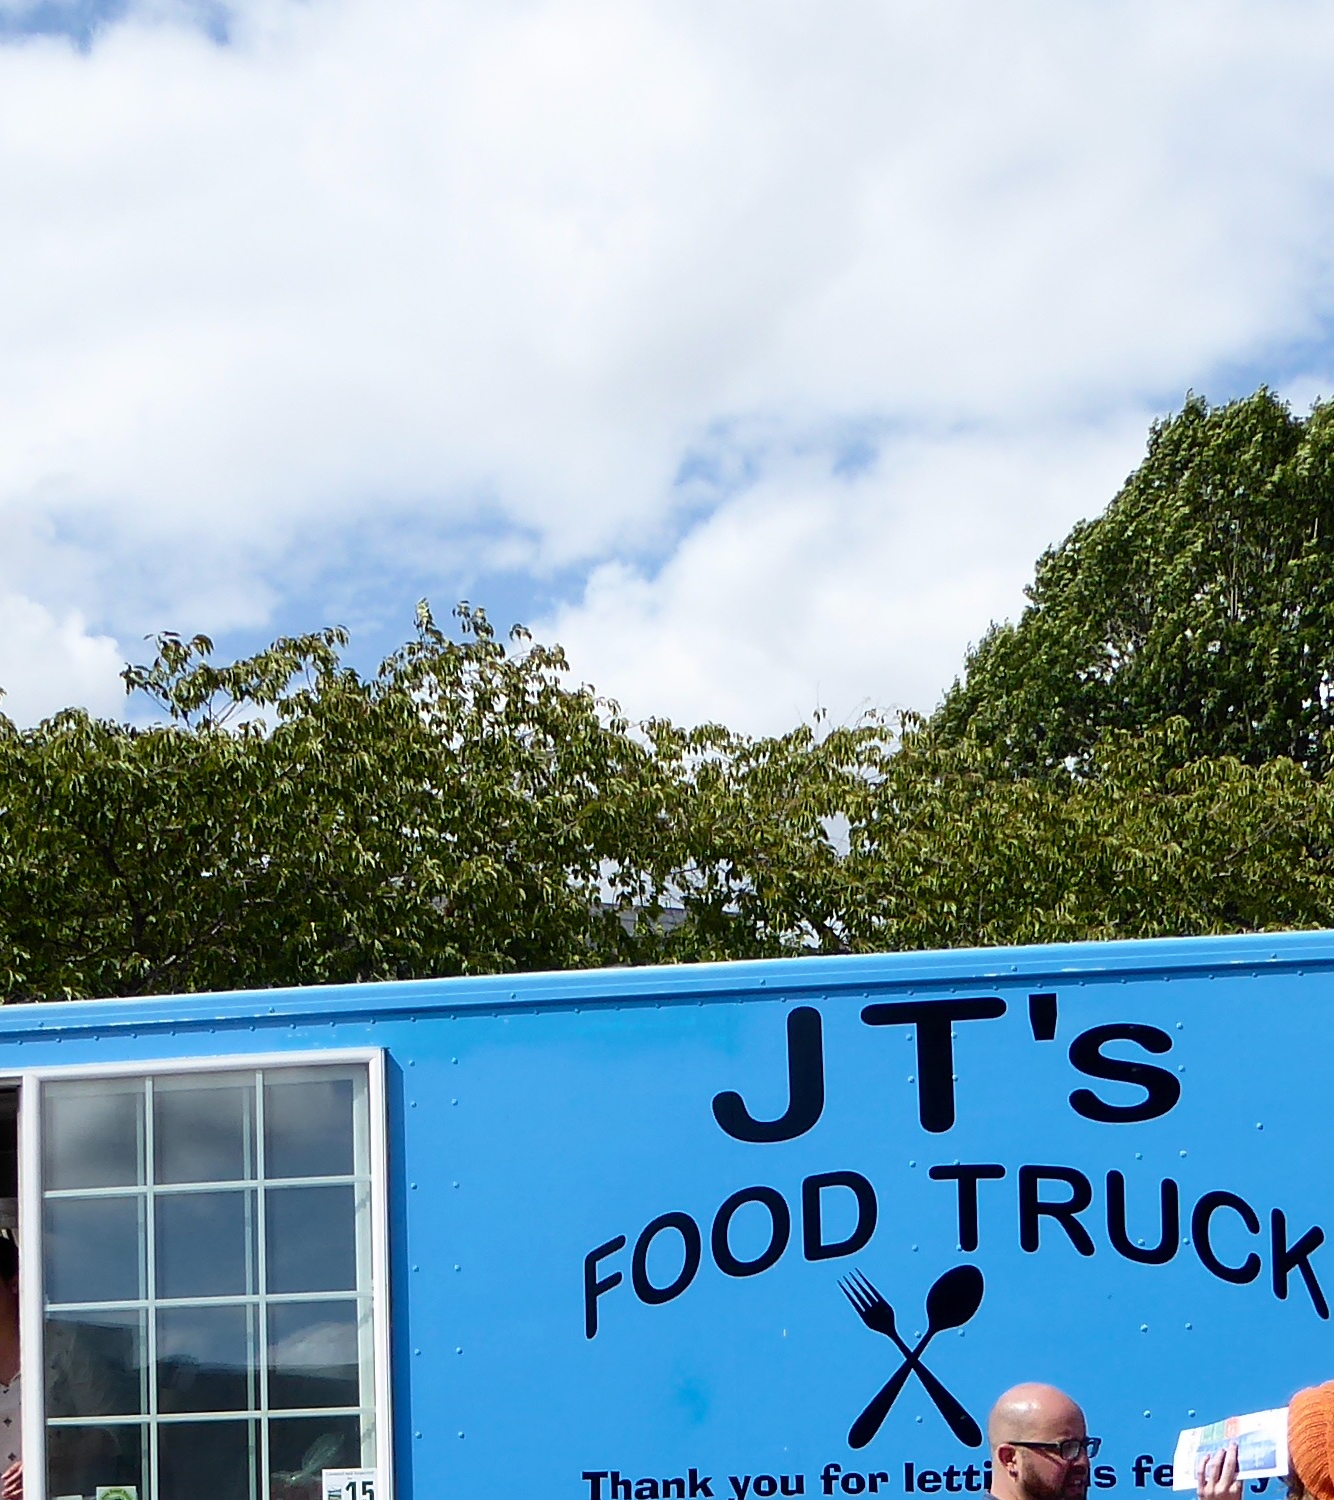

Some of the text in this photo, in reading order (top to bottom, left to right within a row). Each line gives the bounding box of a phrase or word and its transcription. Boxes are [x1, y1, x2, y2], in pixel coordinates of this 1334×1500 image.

[712, 993, 1181, 1143] JT's
[583, 1163, 1330, 1340] FOOD TRUCK
[820, 1462, 889, 1496] for
[903, 1461, 993, 1494] letti
[1085, 1465, 1117, 1489] s
[1132, 1454, 1174, 1488] fe
